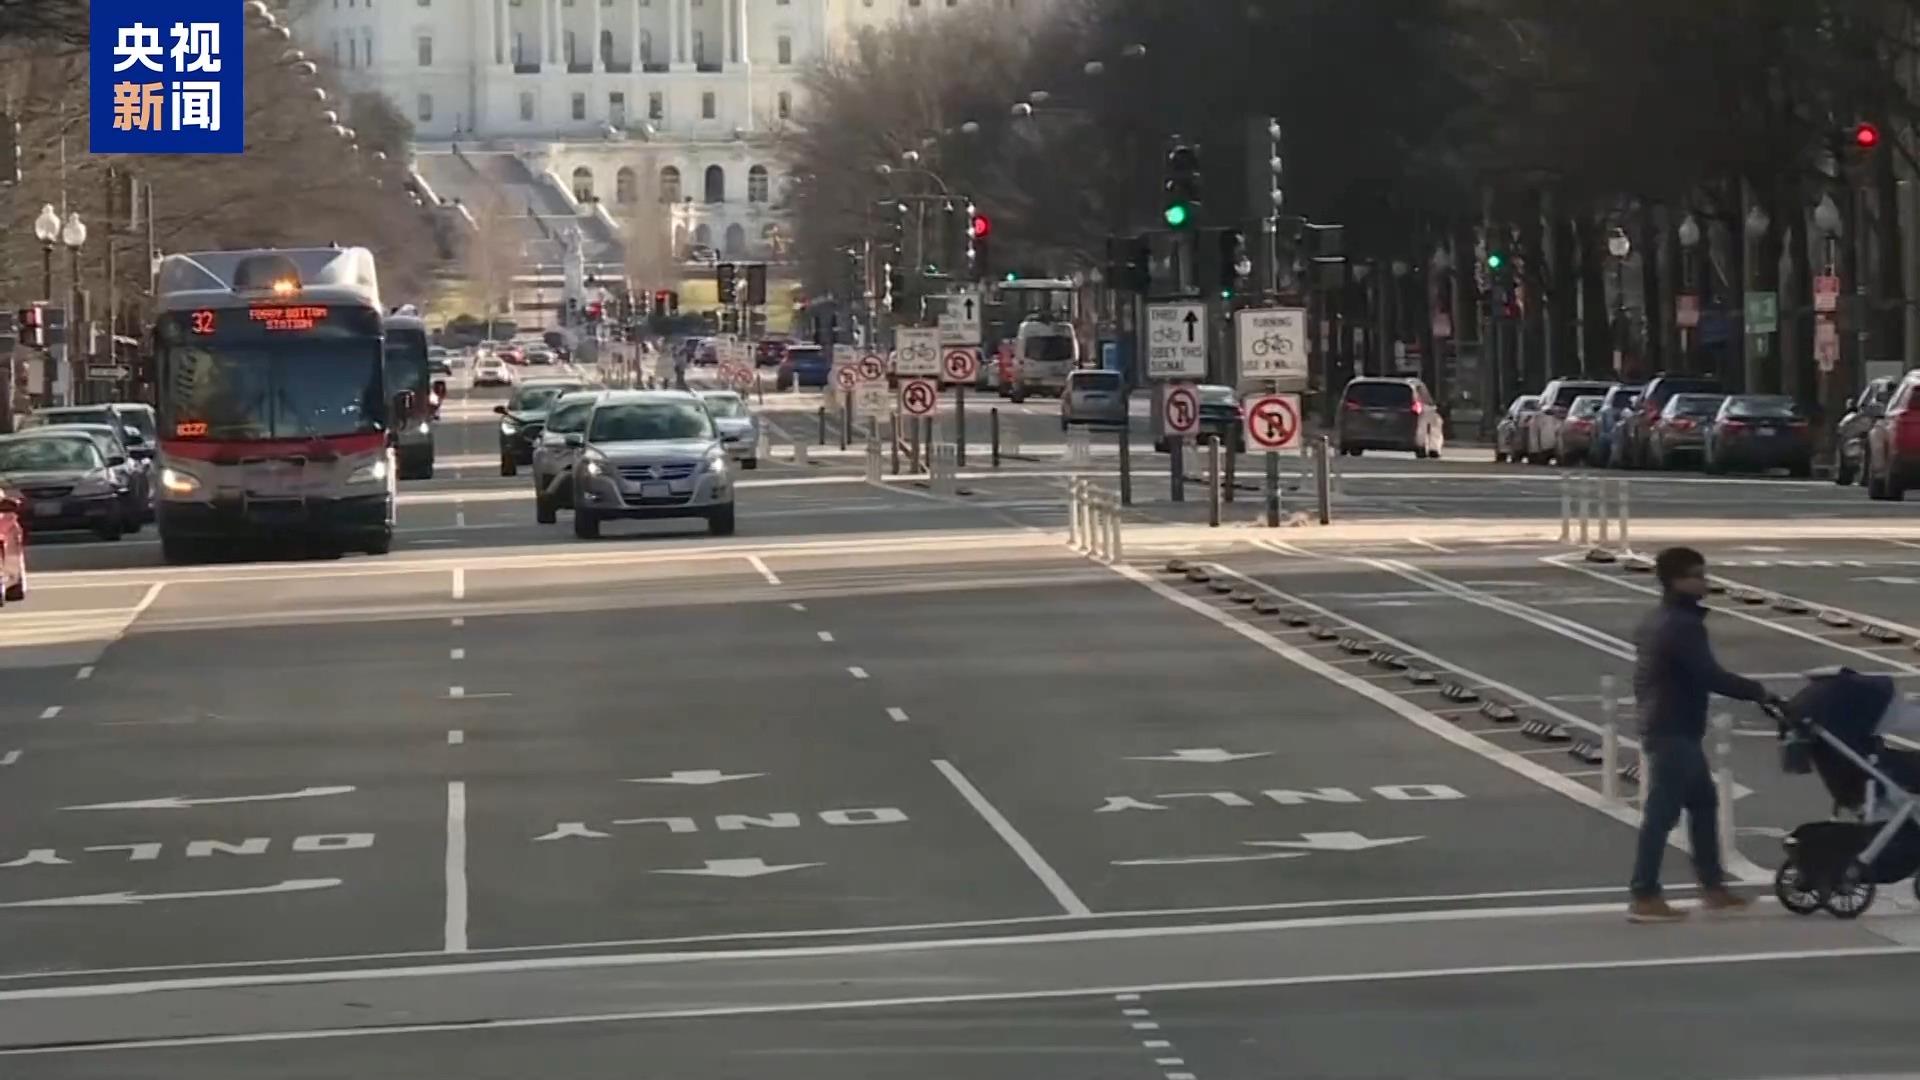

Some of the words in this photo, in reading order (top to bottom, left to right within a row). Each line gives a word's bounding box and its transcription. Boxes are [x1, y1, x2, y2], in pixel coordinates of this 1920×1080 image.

[191, 311, 215, 333] 32
[266, 319, 313, 330] STATION
[285, 307, 327, 319] BOTTOM
[1094, 784, 1468, 812] ONLY
[532, 808, 909, 840] ONLY
[0, 833, 376, 867] ONLY
